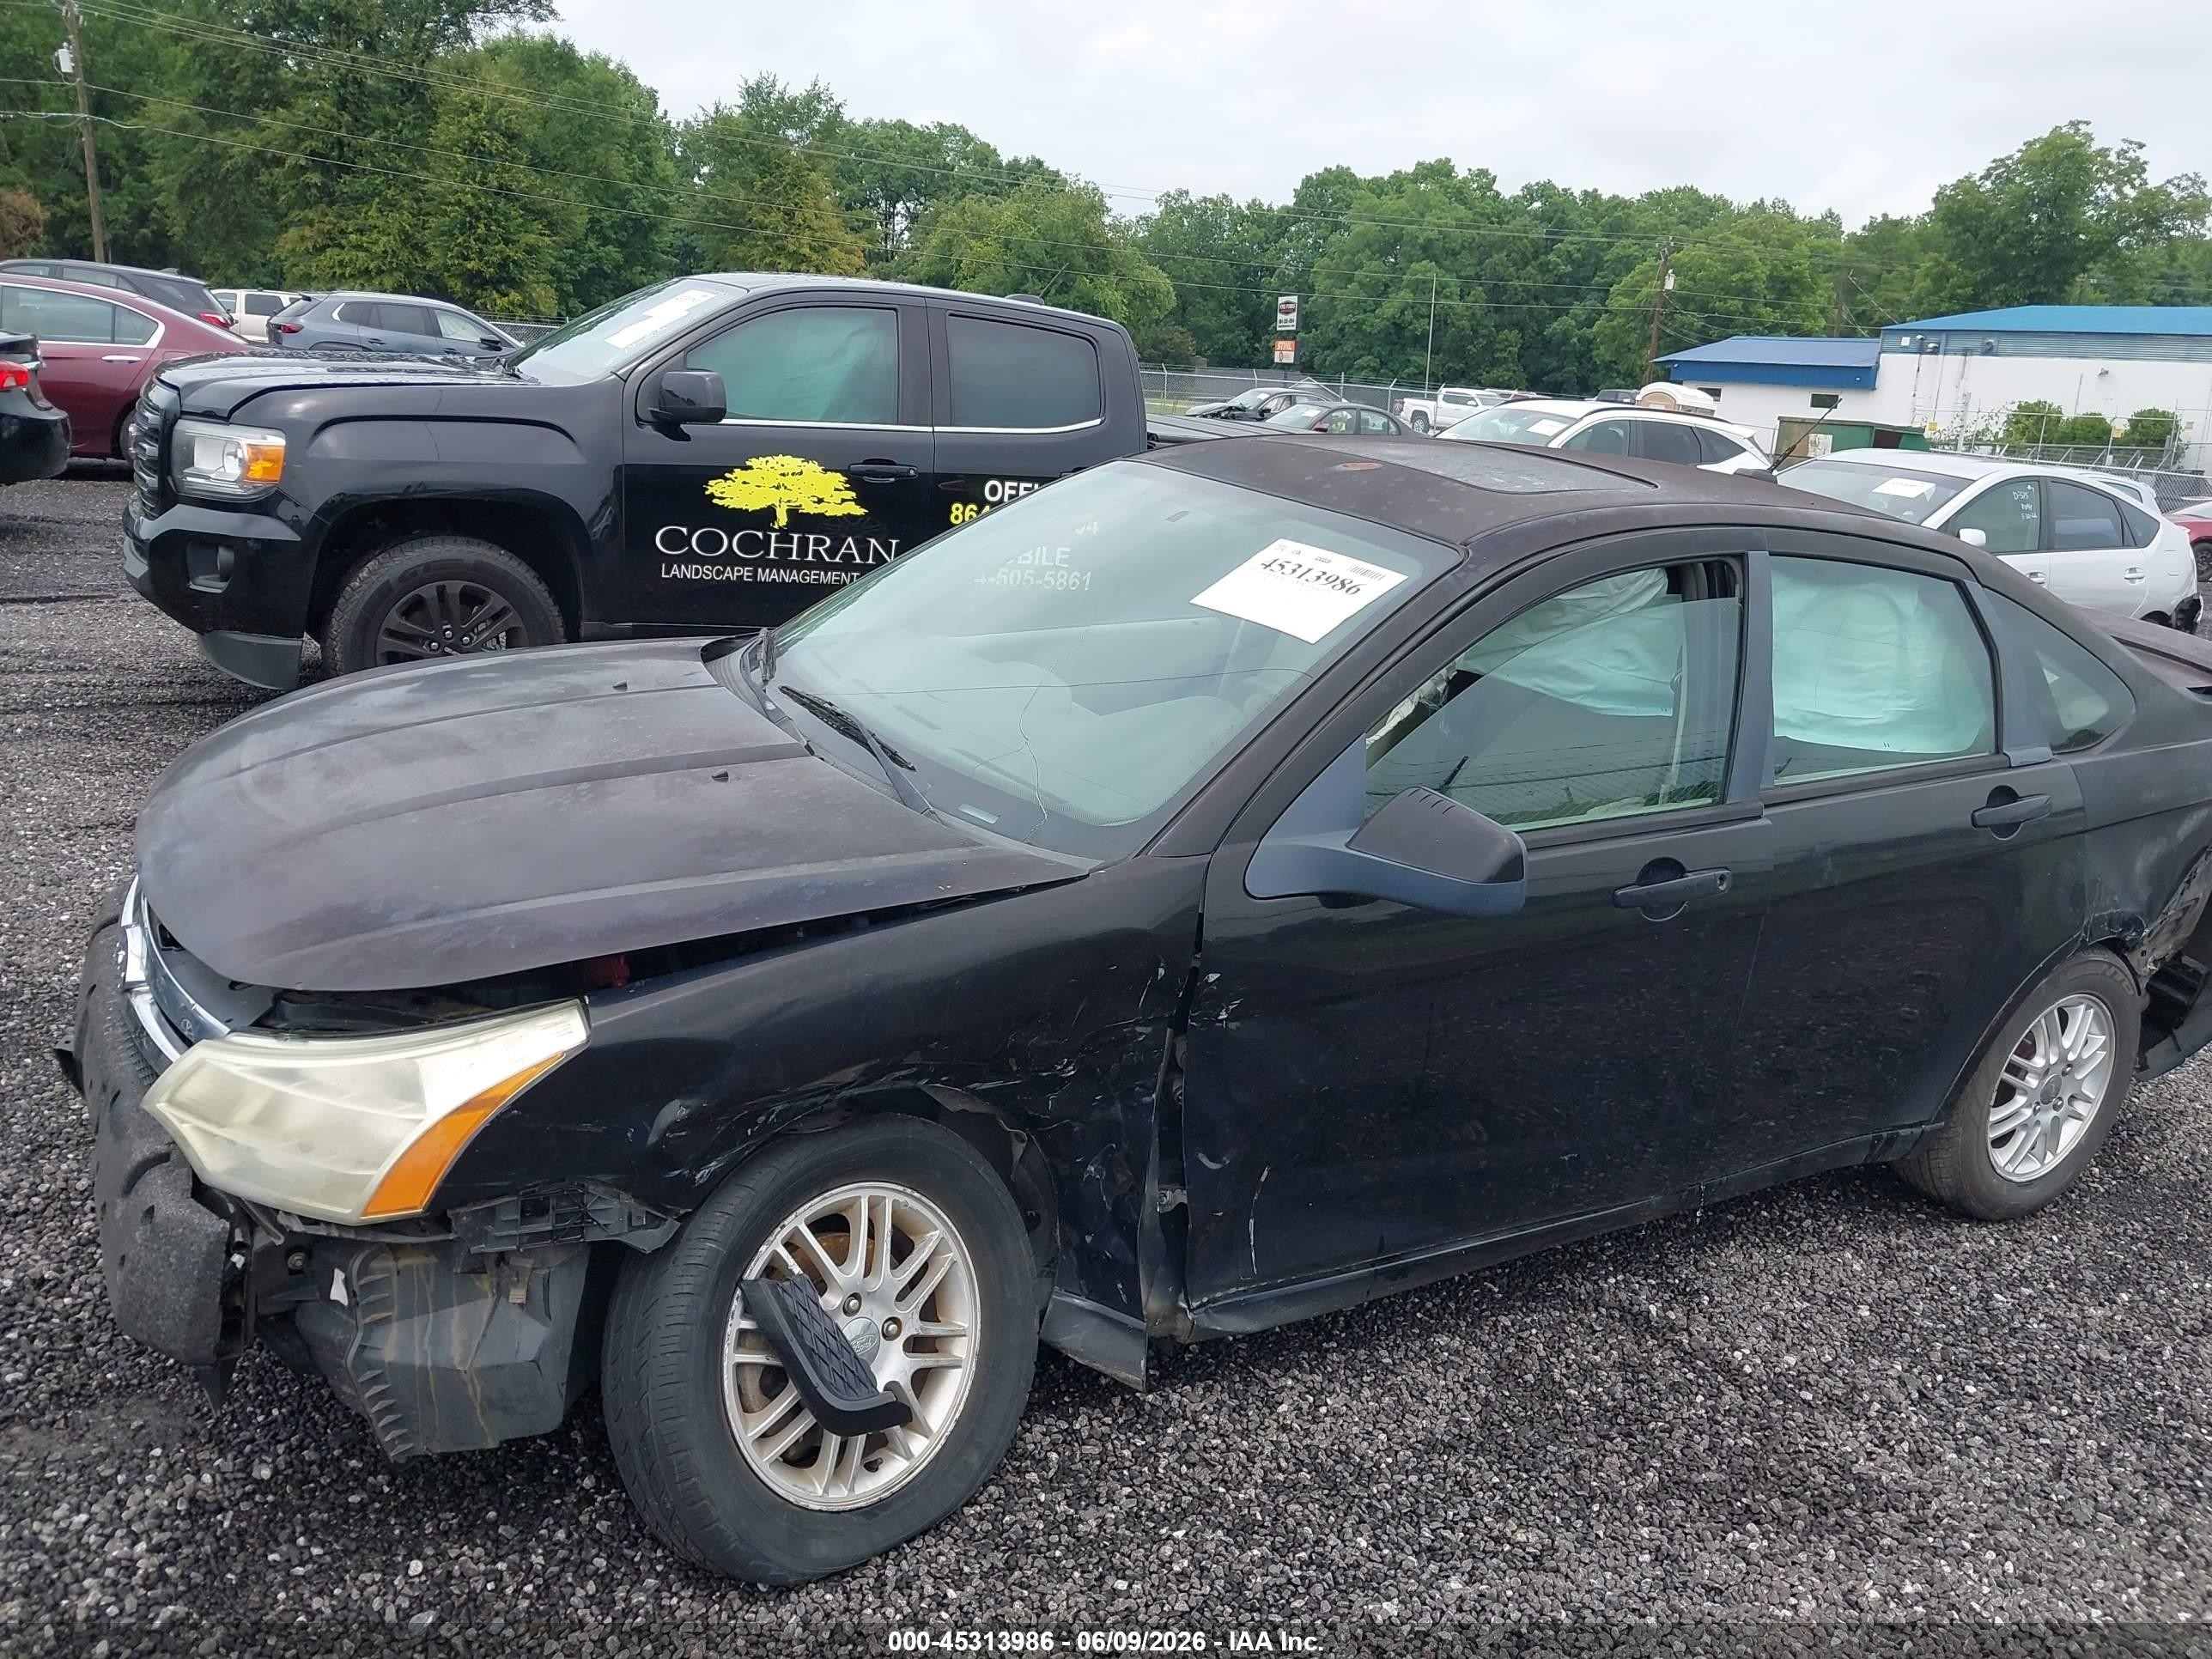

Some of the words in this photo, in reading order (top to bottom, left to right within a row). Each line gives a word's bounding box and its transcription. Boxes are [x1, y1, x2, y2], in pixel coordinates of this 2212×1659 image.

[655, 526, 900, 564] COCHRAN
[661, 563, 753, 582] LANDSCAPE
[757, 568, 860, 586] MANAGEMENT
[1261, 557, 1366, 595] 45313986
